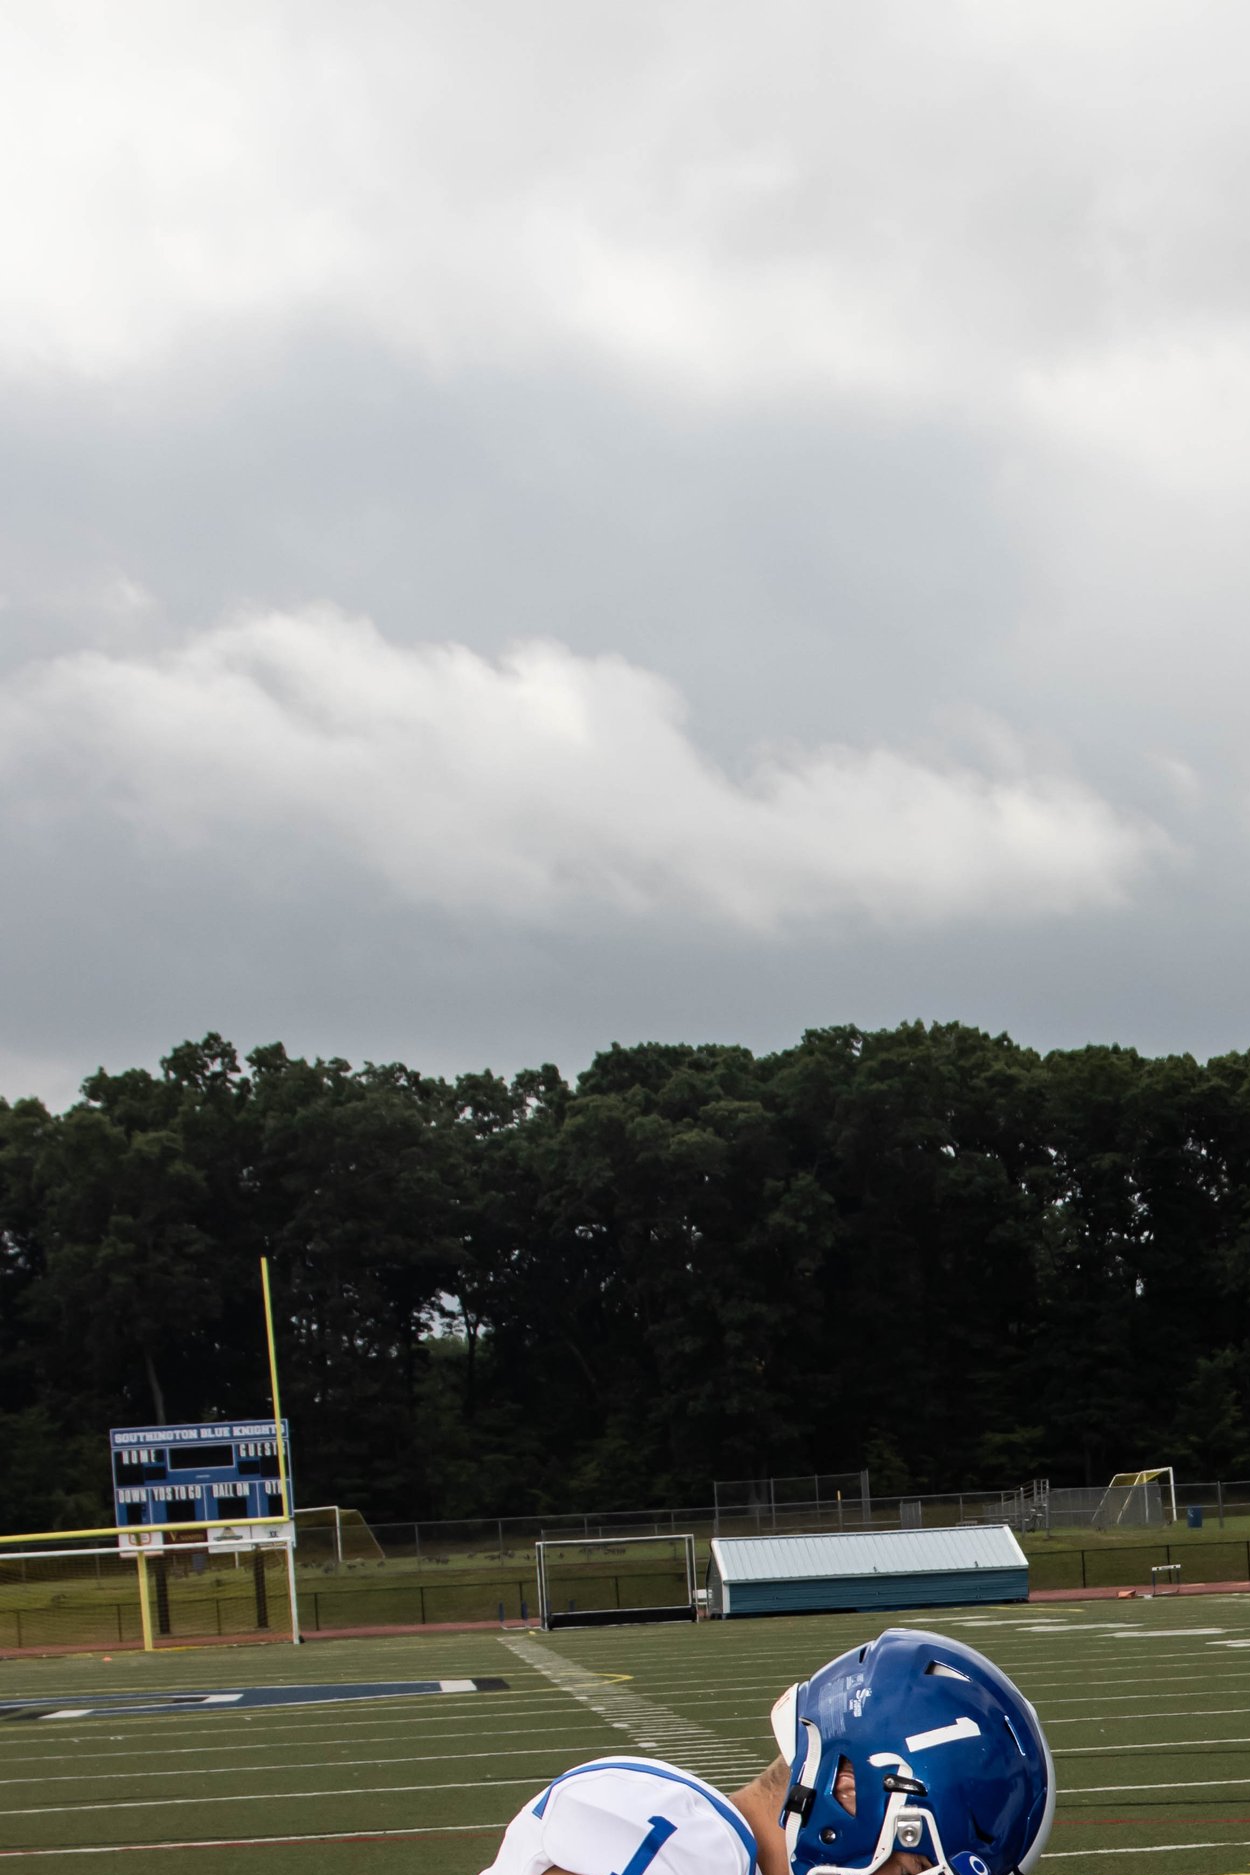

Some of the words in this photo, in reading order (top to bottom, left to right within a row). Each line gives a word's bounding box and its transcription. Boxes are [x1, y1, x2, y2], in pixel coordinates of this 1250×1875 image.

[114, 1429, 198, 1444] SOUTHINGTON
[200, 1427, 230, 1438] BLUE
[122, 1449, 155, 1465] HOME
[118, 1489, 147, 1503] DOWN
[152, 1487, 173, 1501] YDS
[174, 1486, 187, 1500] TO
[188, 1485, 202, 1499] GO
[213, 1483, 234, 1498] BALL
[236, 1482, 250, 1497] ON
[905, 1716, 982, 1753] 1
